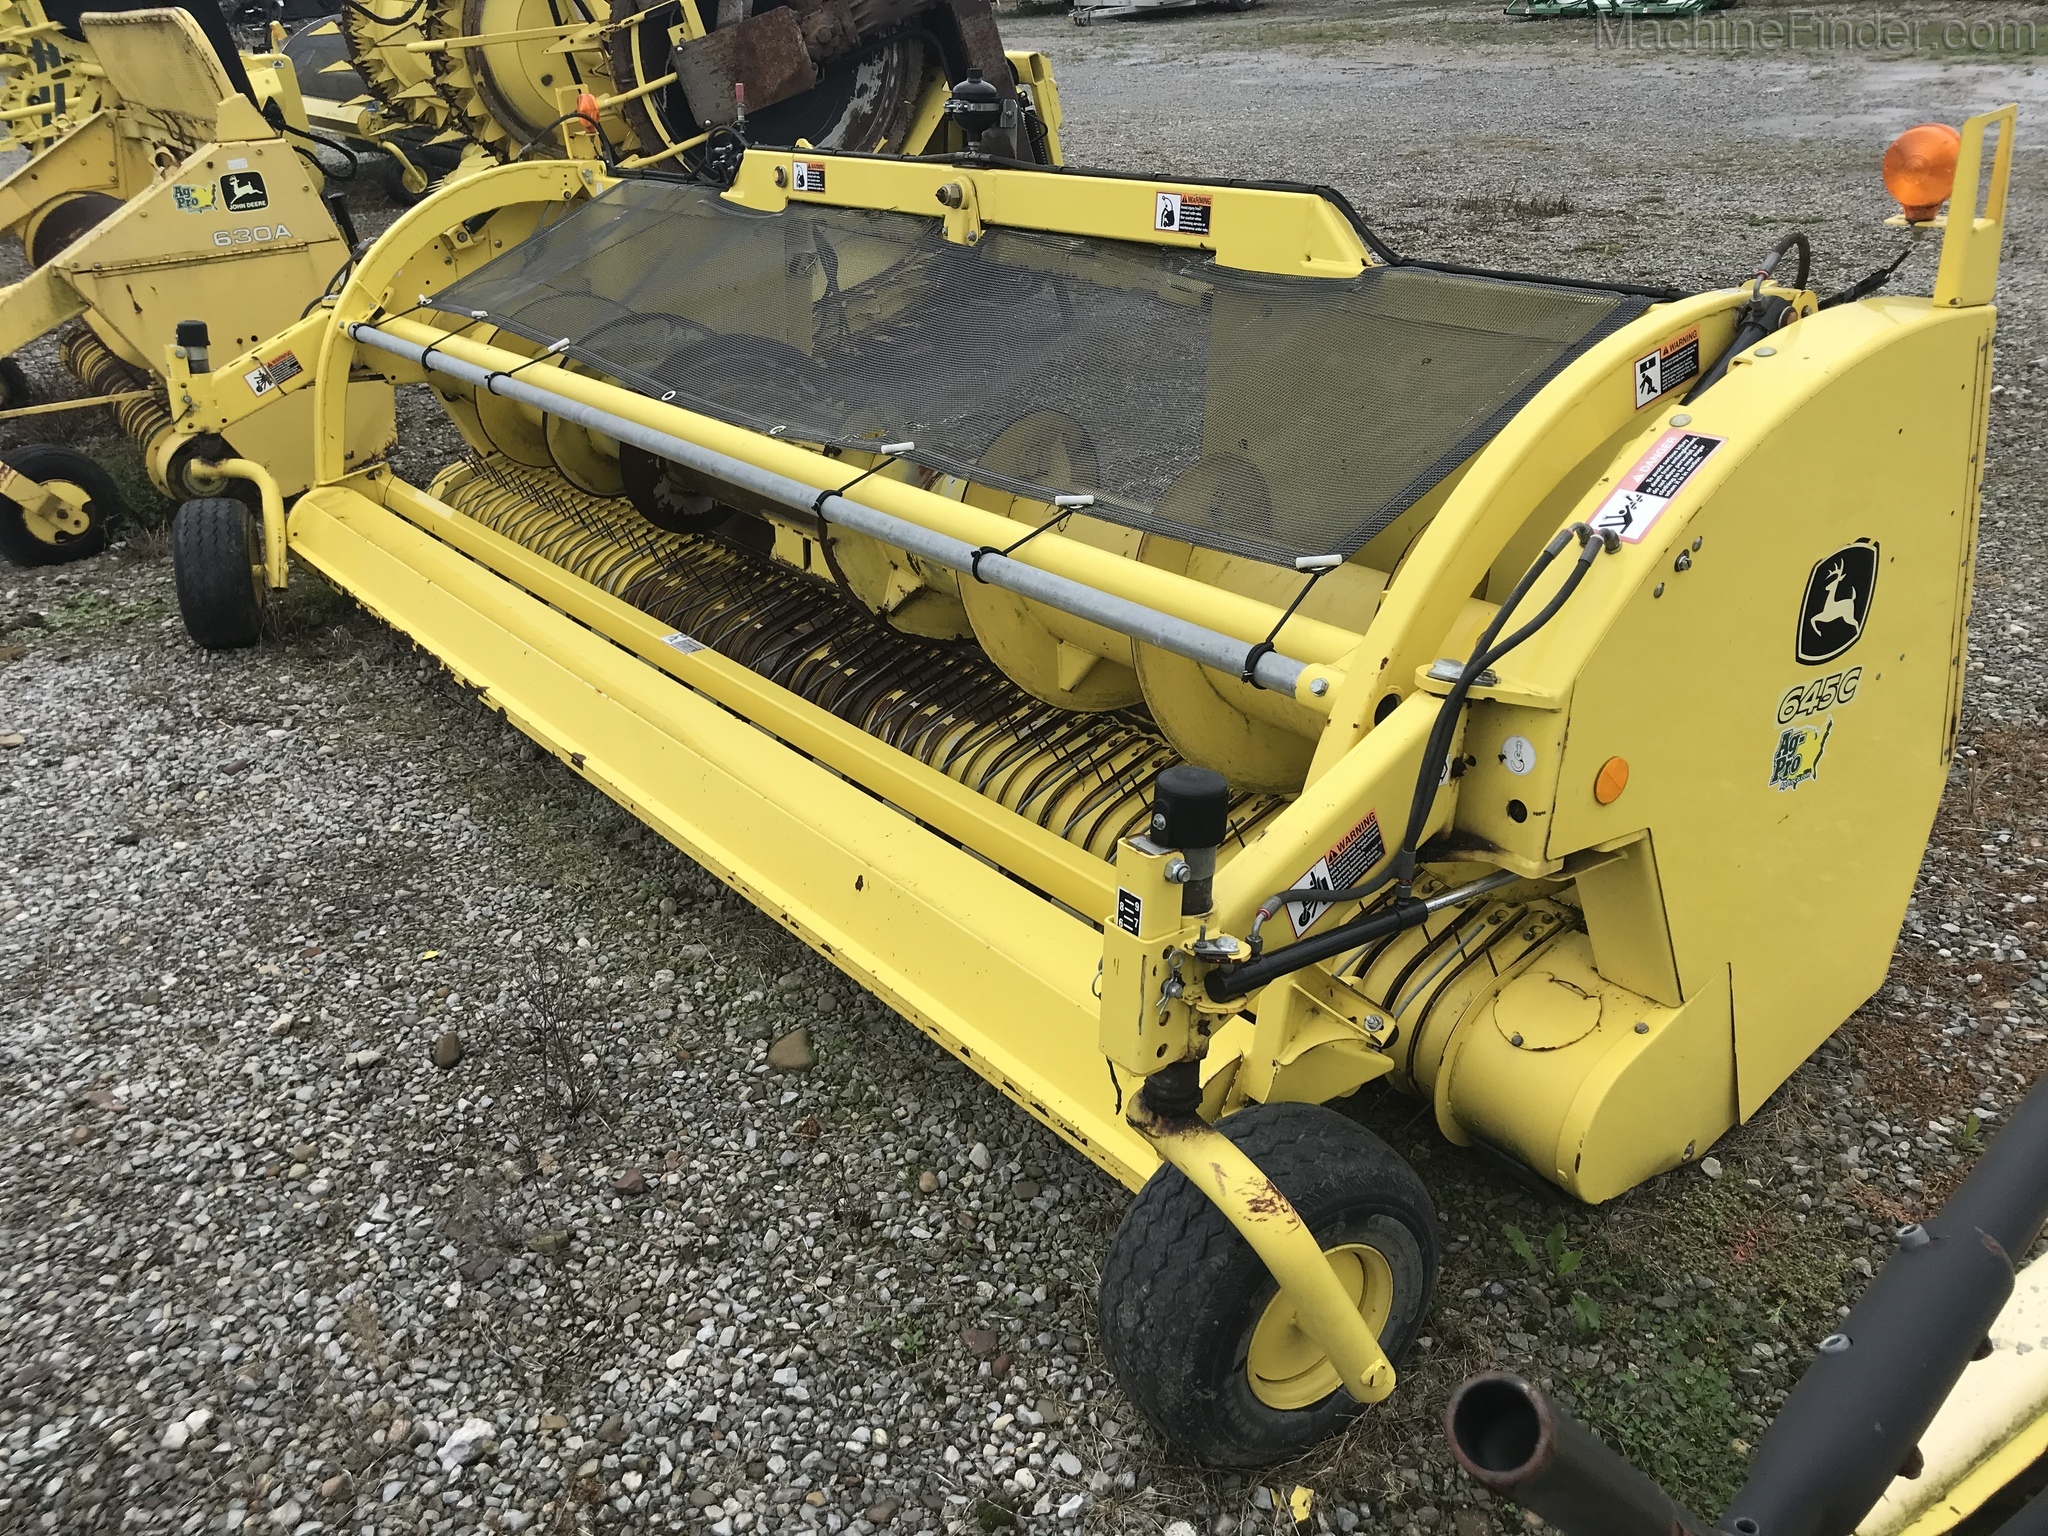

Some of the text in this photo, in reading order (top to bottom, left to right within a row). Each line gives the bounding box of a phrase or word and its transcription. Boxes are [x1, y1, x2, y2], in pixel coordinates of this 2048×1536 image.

[174, 186, 195, 198] Ag-
[176, 197, 198, 208] Pro
[229, 200, 267, 210] JOHN DEERE
[1188, 196, 1211, 205] WARNING
[213, 224, 292, 246] 630A
[1669, 330, 1698, 352] WARNING
[1640, 436, 1678, 472] DANGER
[1778, 666, 1862, 724] 645C
[1776, 729, 1807, 758] Ag-
[1770, 754, 1802, 786] Pro
[1336, 812, 1376, 852] WARNING
[1120, 901, 1124, 912] 8
[1134, 902, 1140, 912] 9
[1119, 918, 1124, 928] 6
[1134, 918, 1138, 928] 7
